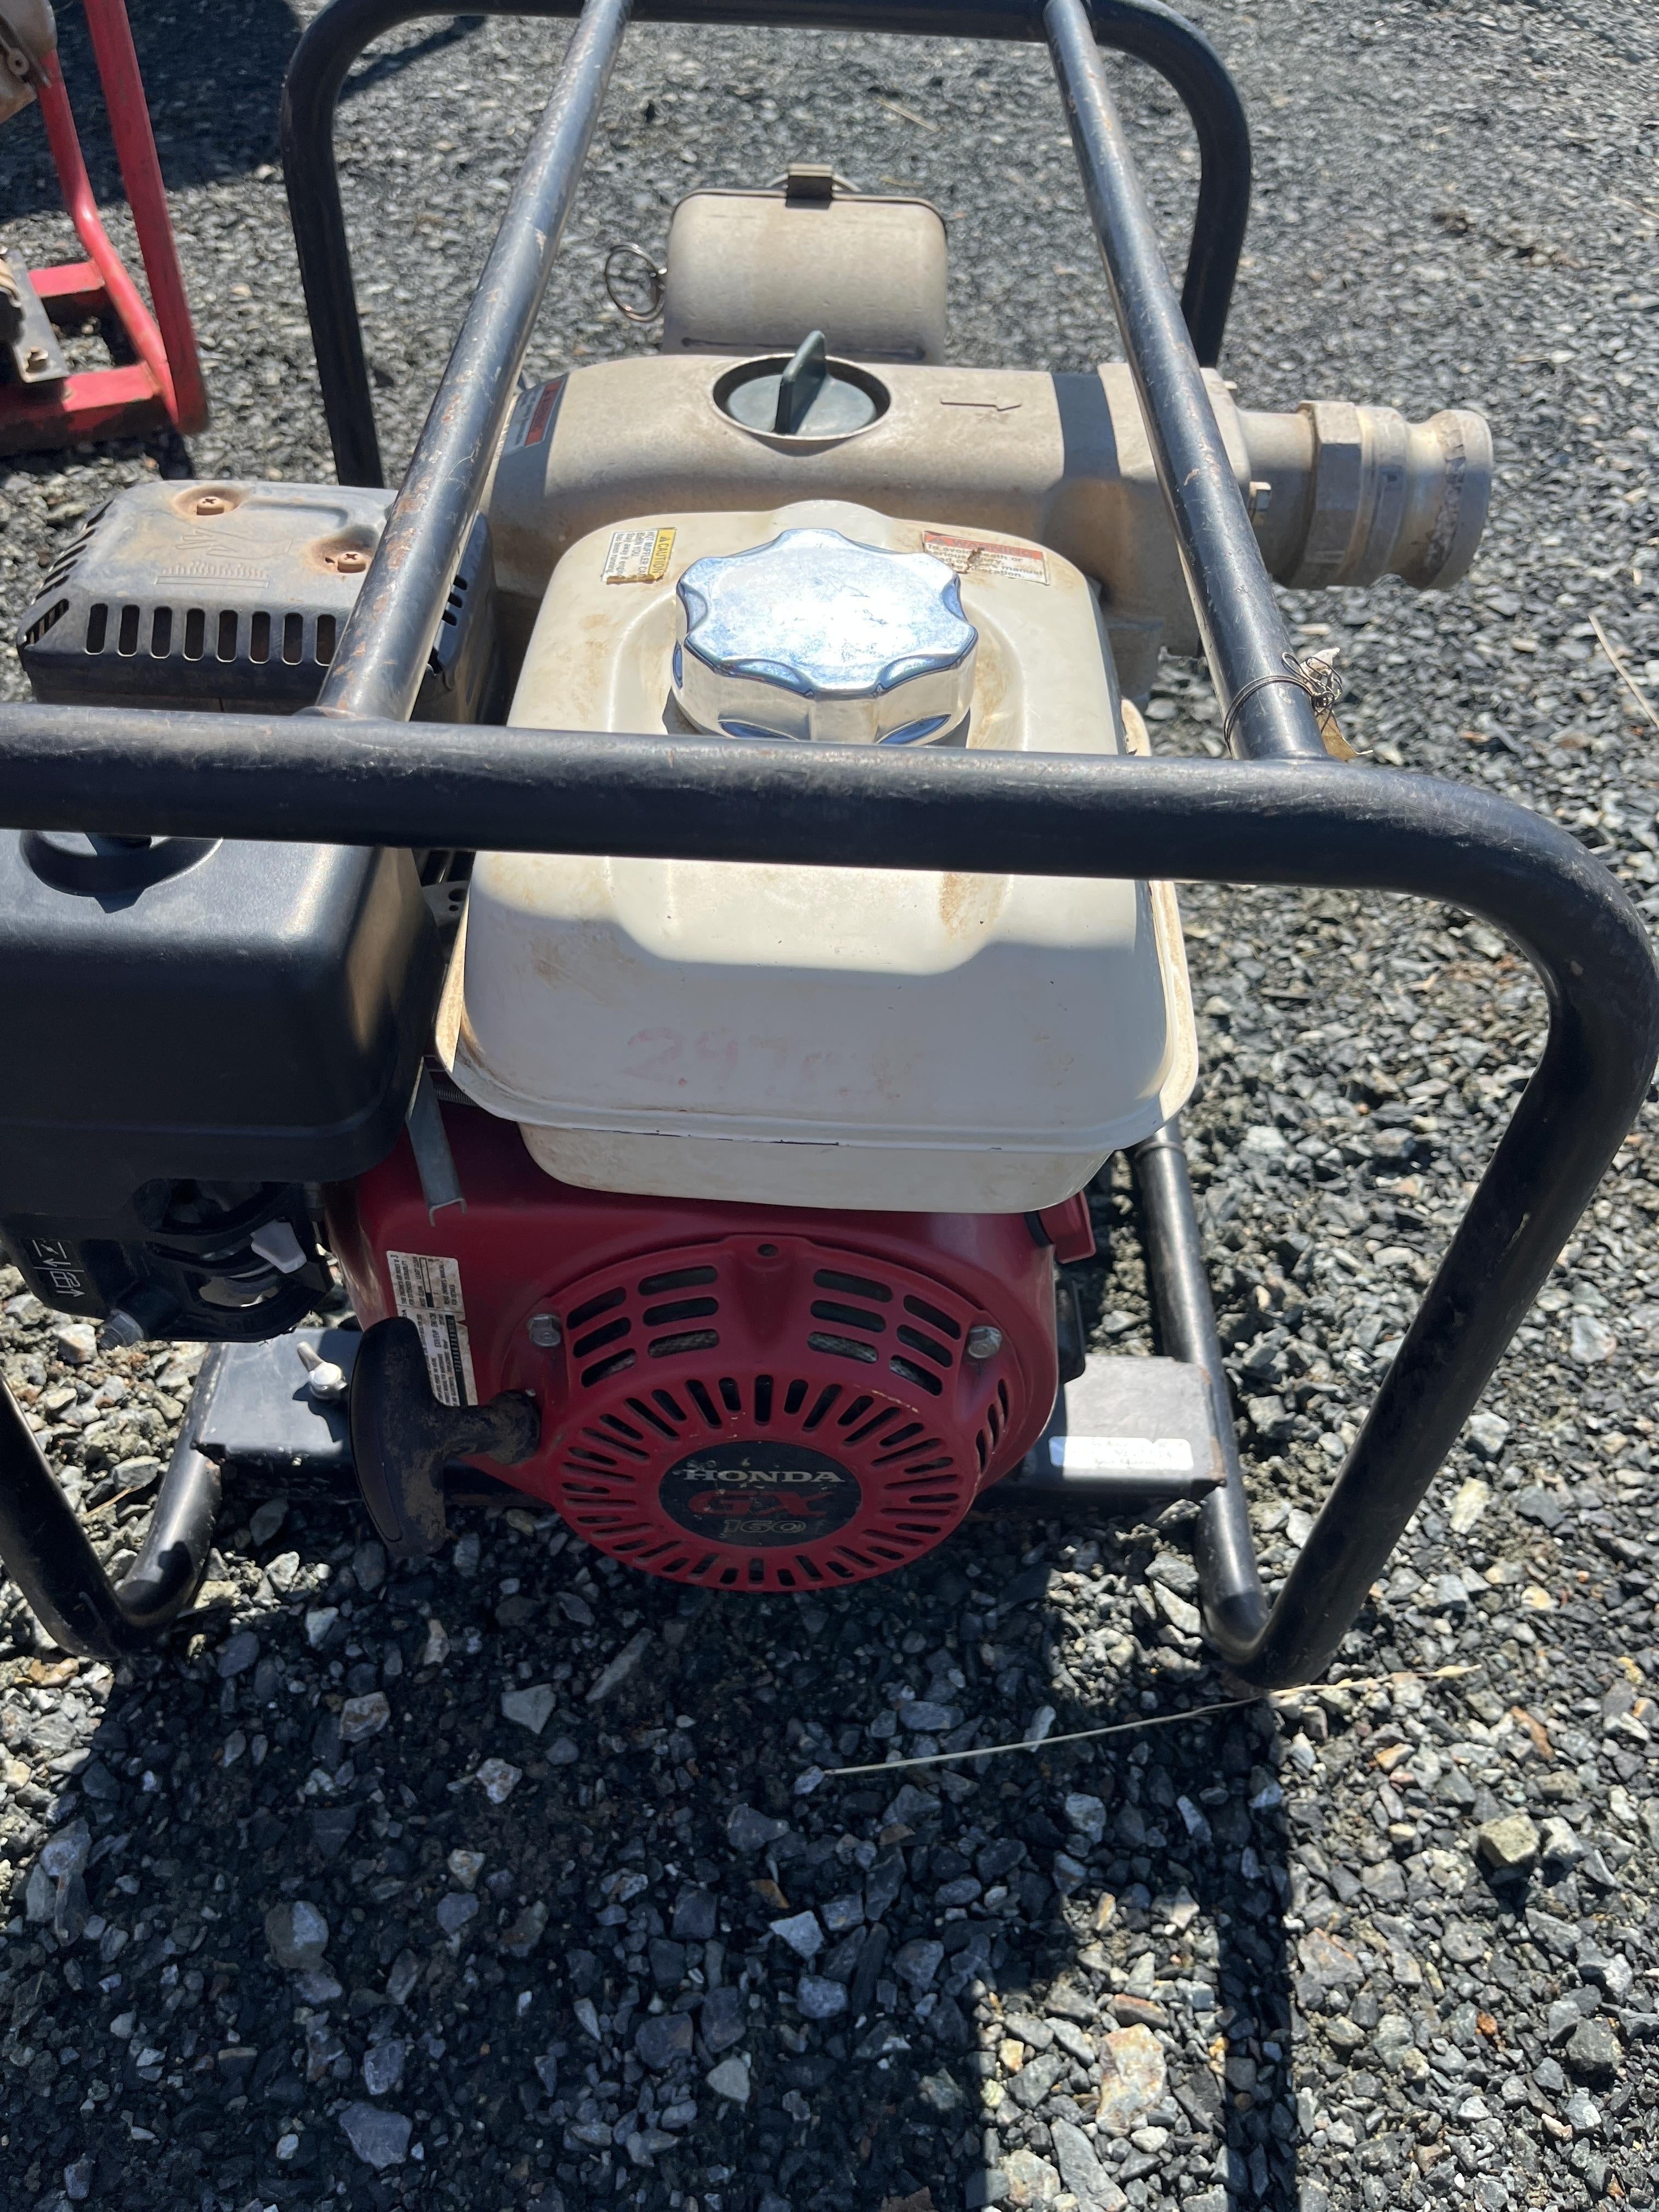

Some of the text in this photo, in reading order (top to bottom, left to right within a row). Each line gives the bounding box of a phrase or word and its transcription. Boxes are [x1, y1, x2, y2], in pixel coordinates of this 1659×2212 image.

[631, 546, 642, 556] YOU
[637, 532, 655, 575] HOT MUFFLER CA
[652, 544, 669, 574] CAUTION
[1002, 566, 1042, 575] manual
[683, 1469, 845, 1483] HONDA
[689, 1489, 834, 1517] GX
[724, 1519, 806, 1533] 160
